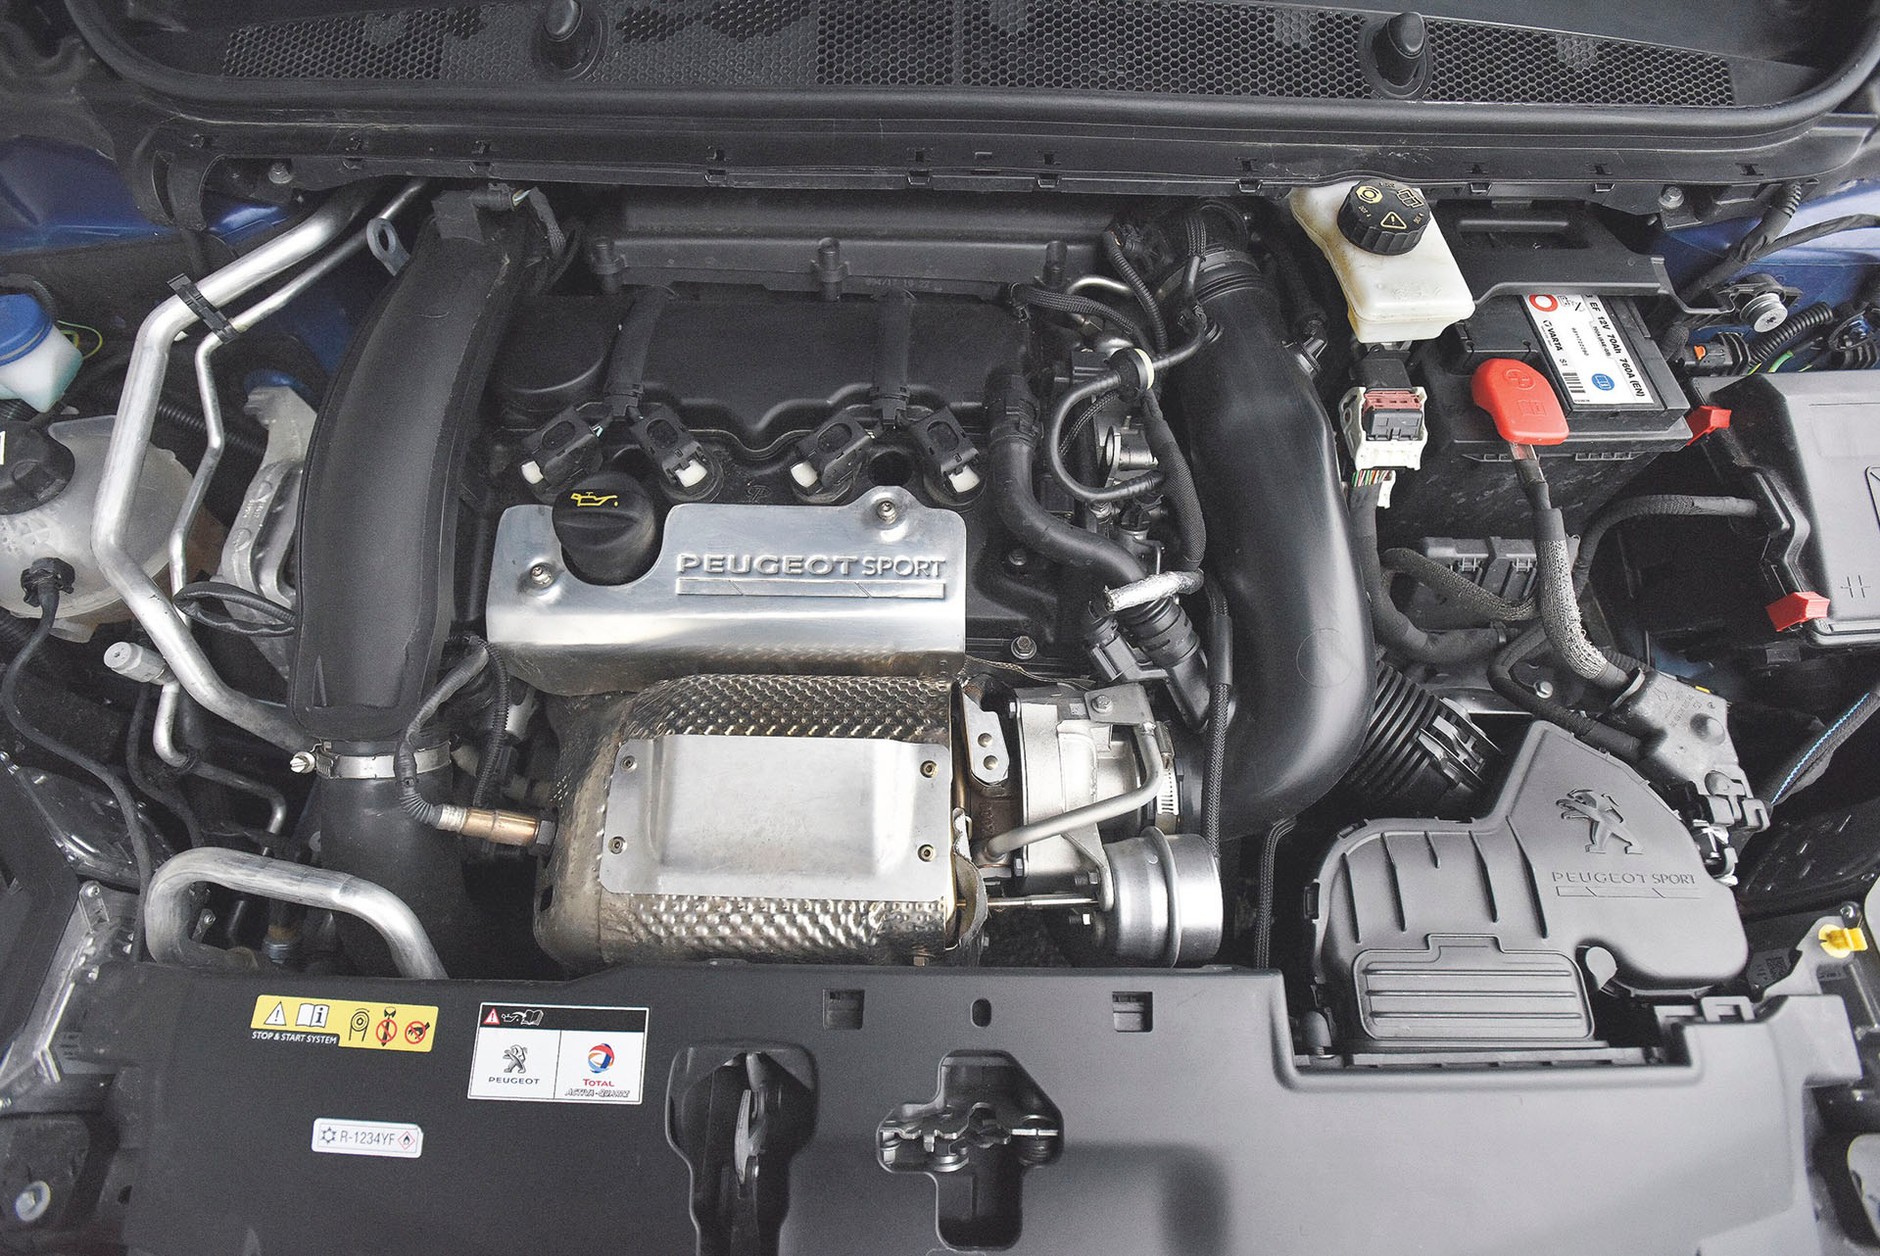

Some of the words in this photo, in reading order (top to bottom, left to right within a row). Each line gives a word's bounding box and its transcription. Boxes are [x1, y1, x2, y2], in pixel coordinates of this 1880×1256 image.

[1547, 328, 1563, 351] VARTA
[1589, 301, 1601, 312] EF
[1597, 316, 1610, 330] 12V
[1607, 334, 1621, 354] 70Ah
[1619, 358, 1636, 379] 760A
[1630, 380, 1645, 397] (EN)
[676, 552, 858, 575] PEUGEOT
[861, 555, 946, 578] SPORT
[1551, 871, 1647, 884] PEUGEOT
[1651, 873, 1696, 885] SPORT
[251, 1031, 274, 1041] STOP
[273, 1033, 280, 1041] &
[280, 1033, 306, 1043] START
[306, 1035, 338, 1044] SYSTEM
[488, 1076, 540, 1085] PEUGEOT
[583, 1078, 615, 1087] TOTAL
[340, 1130, 396, 1145] R-1234YF
